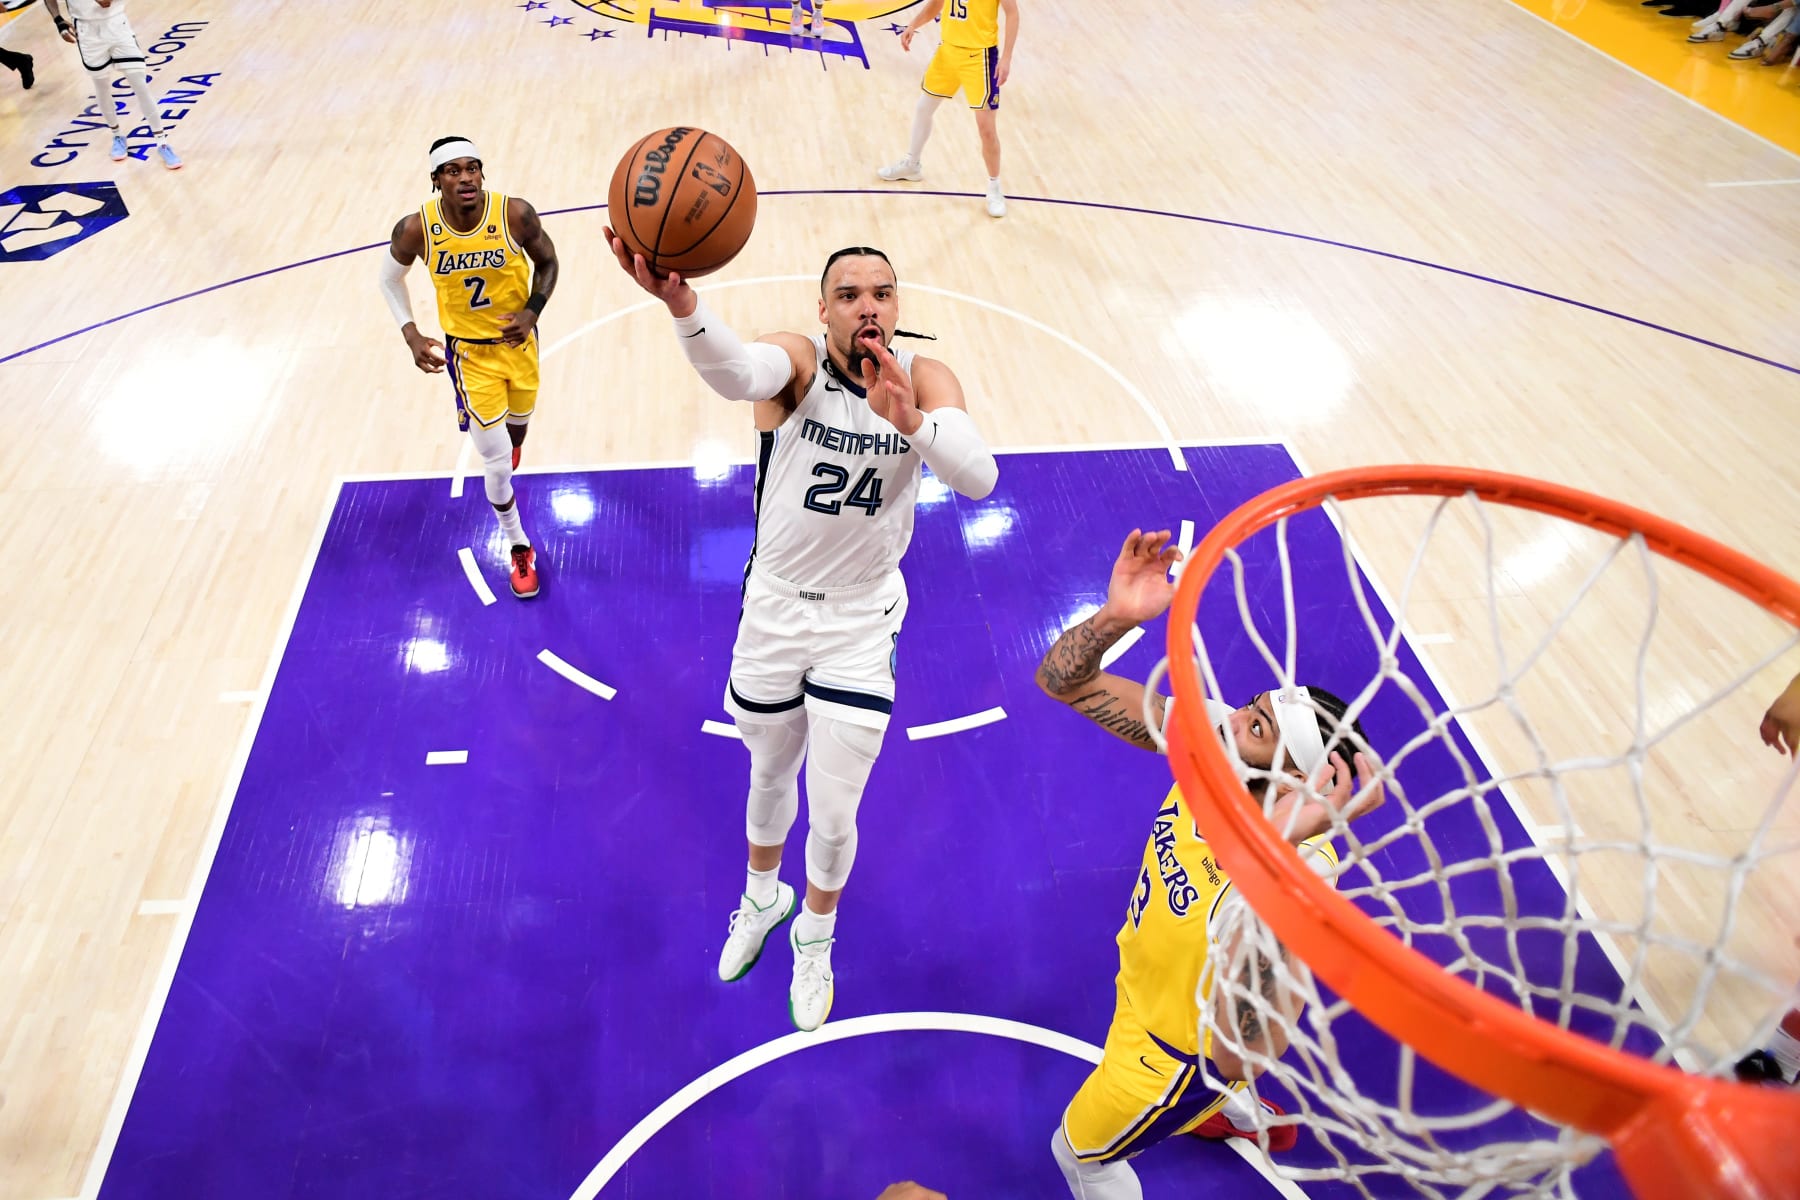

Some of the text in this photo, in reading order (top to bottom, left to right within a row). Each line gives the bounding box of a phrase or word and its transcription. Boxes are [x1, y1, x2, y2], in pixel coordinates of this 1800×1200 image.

[950, 0, 967, 19] 15
[127, 72, 222, 161] ARENA
[634, 127, 694, 208] Wilson
[433, 224, 441, 235] 6
[434, 248, 506, 275] LAKERS
[463, 276, 491, 309] 2
[801, 418, 911, 455] MEMPHIS
[803, 461, 883, 516] 24
[1201, 856, 1221, 886] bibigo
